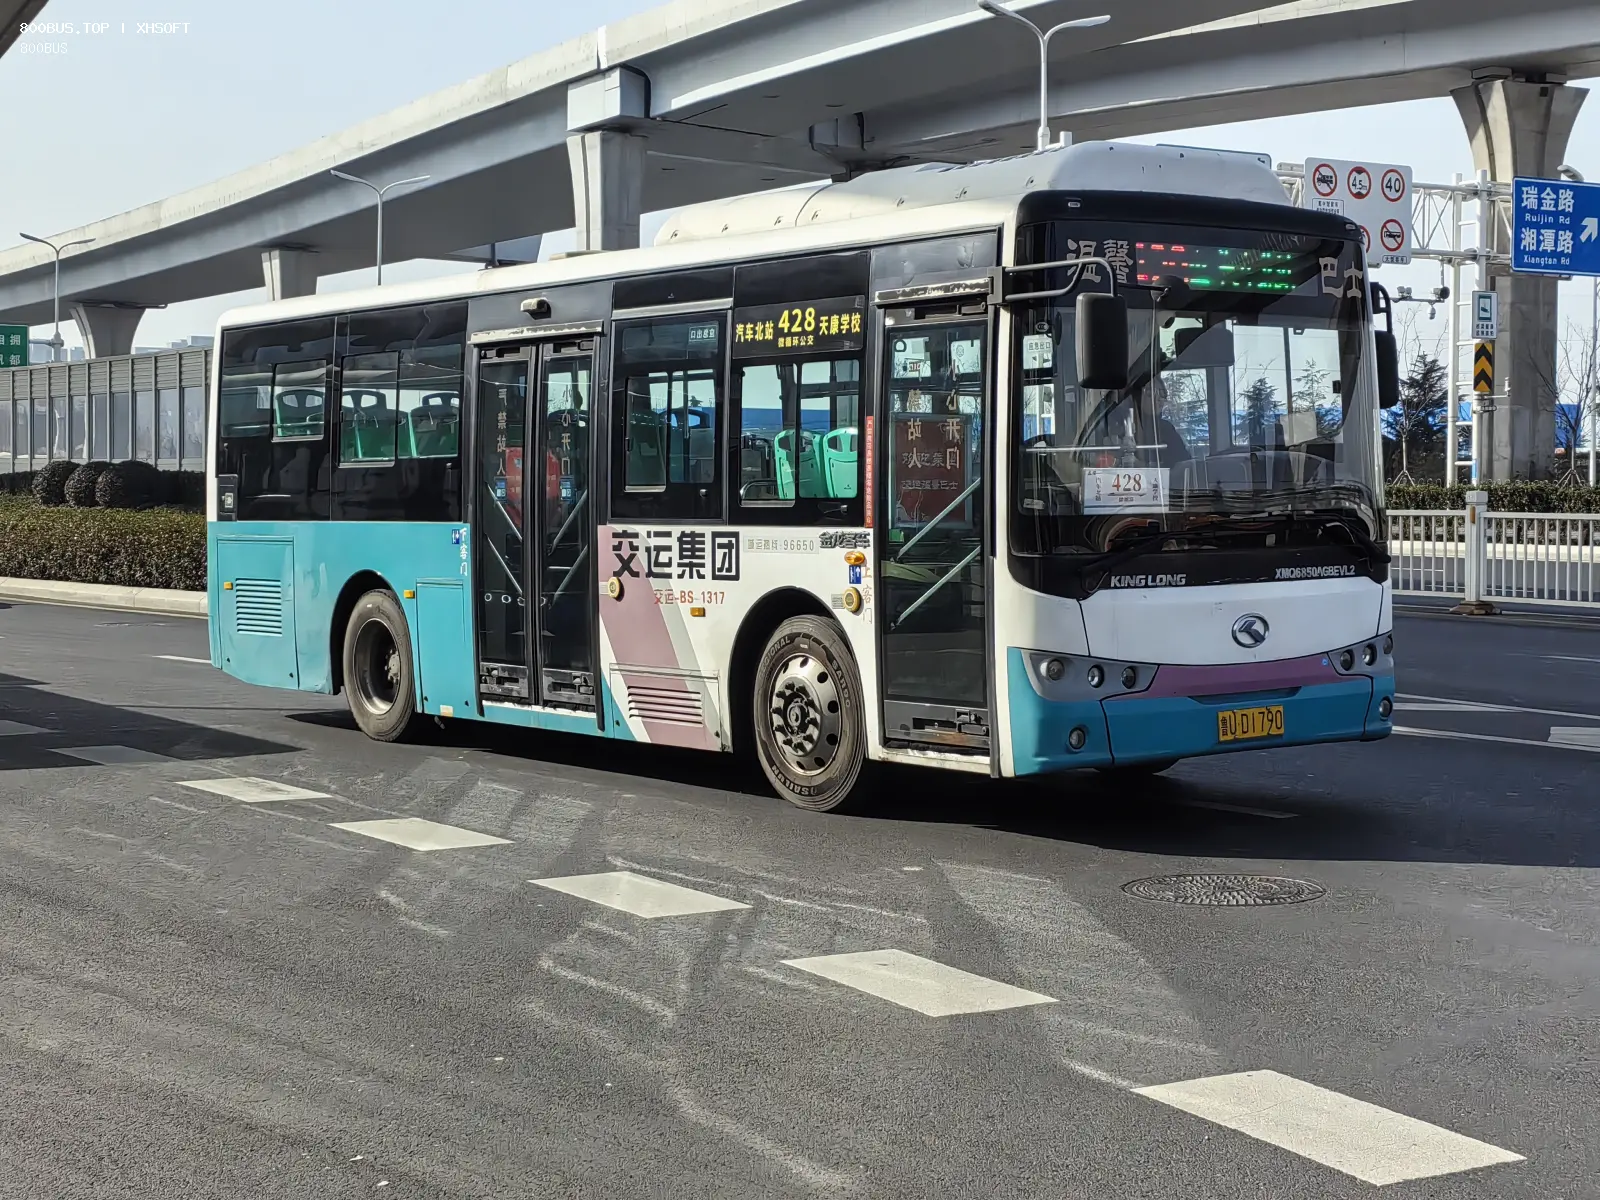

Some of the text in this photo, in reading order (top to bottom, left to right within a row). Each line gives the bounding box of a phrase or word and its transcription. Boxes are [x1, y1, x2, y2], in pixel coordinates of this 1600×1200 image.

[1385, 176, 1401, 193] 40
[1521, 185, 1575, 213] 瑞金路
[1525, 213, 1570, 224] Ruijin Rd
[1520, 226, 1574, 254] 湘潭路
[1523, 254, 1570, 266] Xiangtan Rd
[1318, 256, 1363, 299] 巴士
[735, 320, 774, 343] 汽车北站
[778, 307, 816, 333] 428
[818, 312, 861, 336] 天康学校
[1112, 473, 1142, 492] 428
[612, 529, 740, 581] 交运集团
[1110, 573, 1187, 588] KING LONG
[701, 590, 725, 605] 1317
